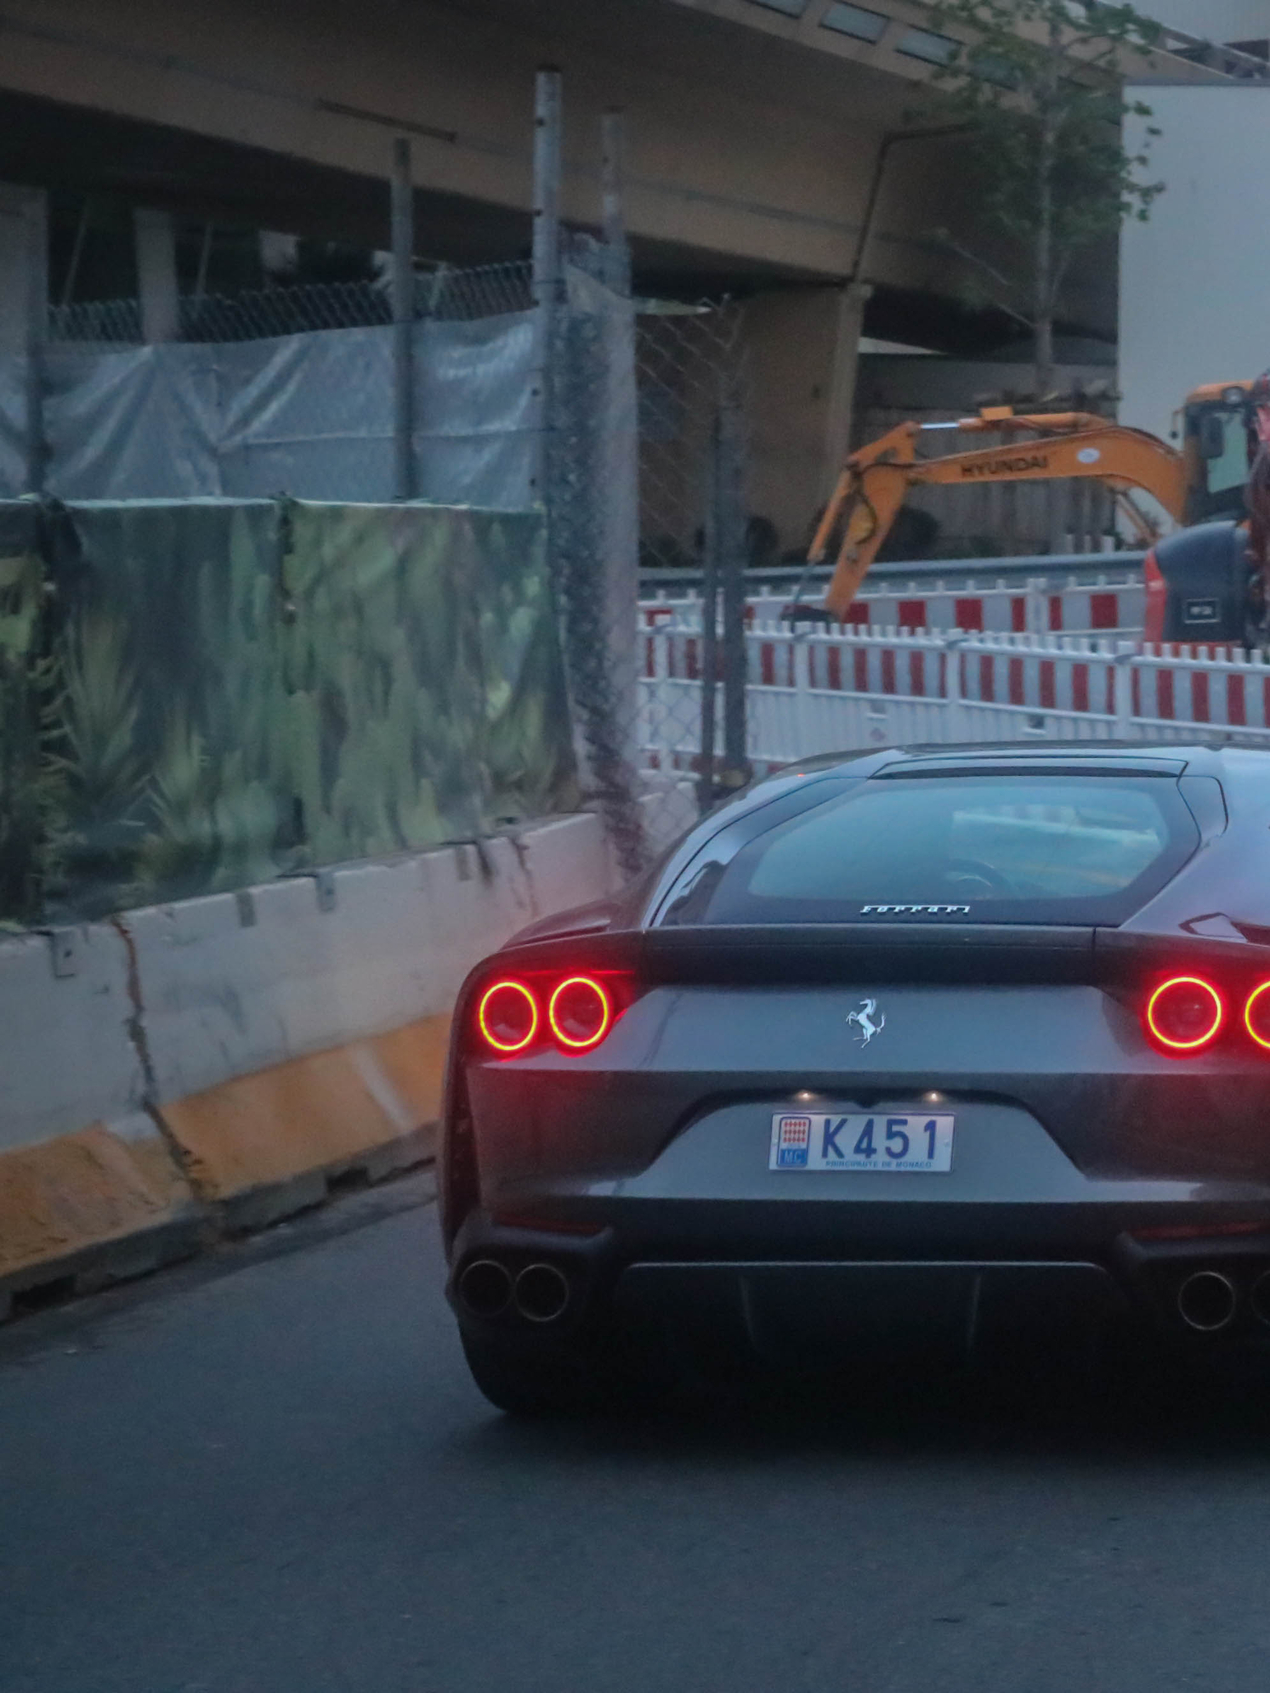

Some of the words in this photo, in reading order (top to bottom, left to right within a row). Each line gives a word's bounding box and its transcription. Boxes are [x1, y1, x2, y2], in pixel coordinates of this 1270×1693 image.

[961, 455, 1048, 478] HYUNDAI
[860, 904, 971, 913] Ferrari
[821, 1118, 937, 1160] K451
[784, 1149, 803, 1163] MC
[895, 1161, 932, 1169] MONACO
